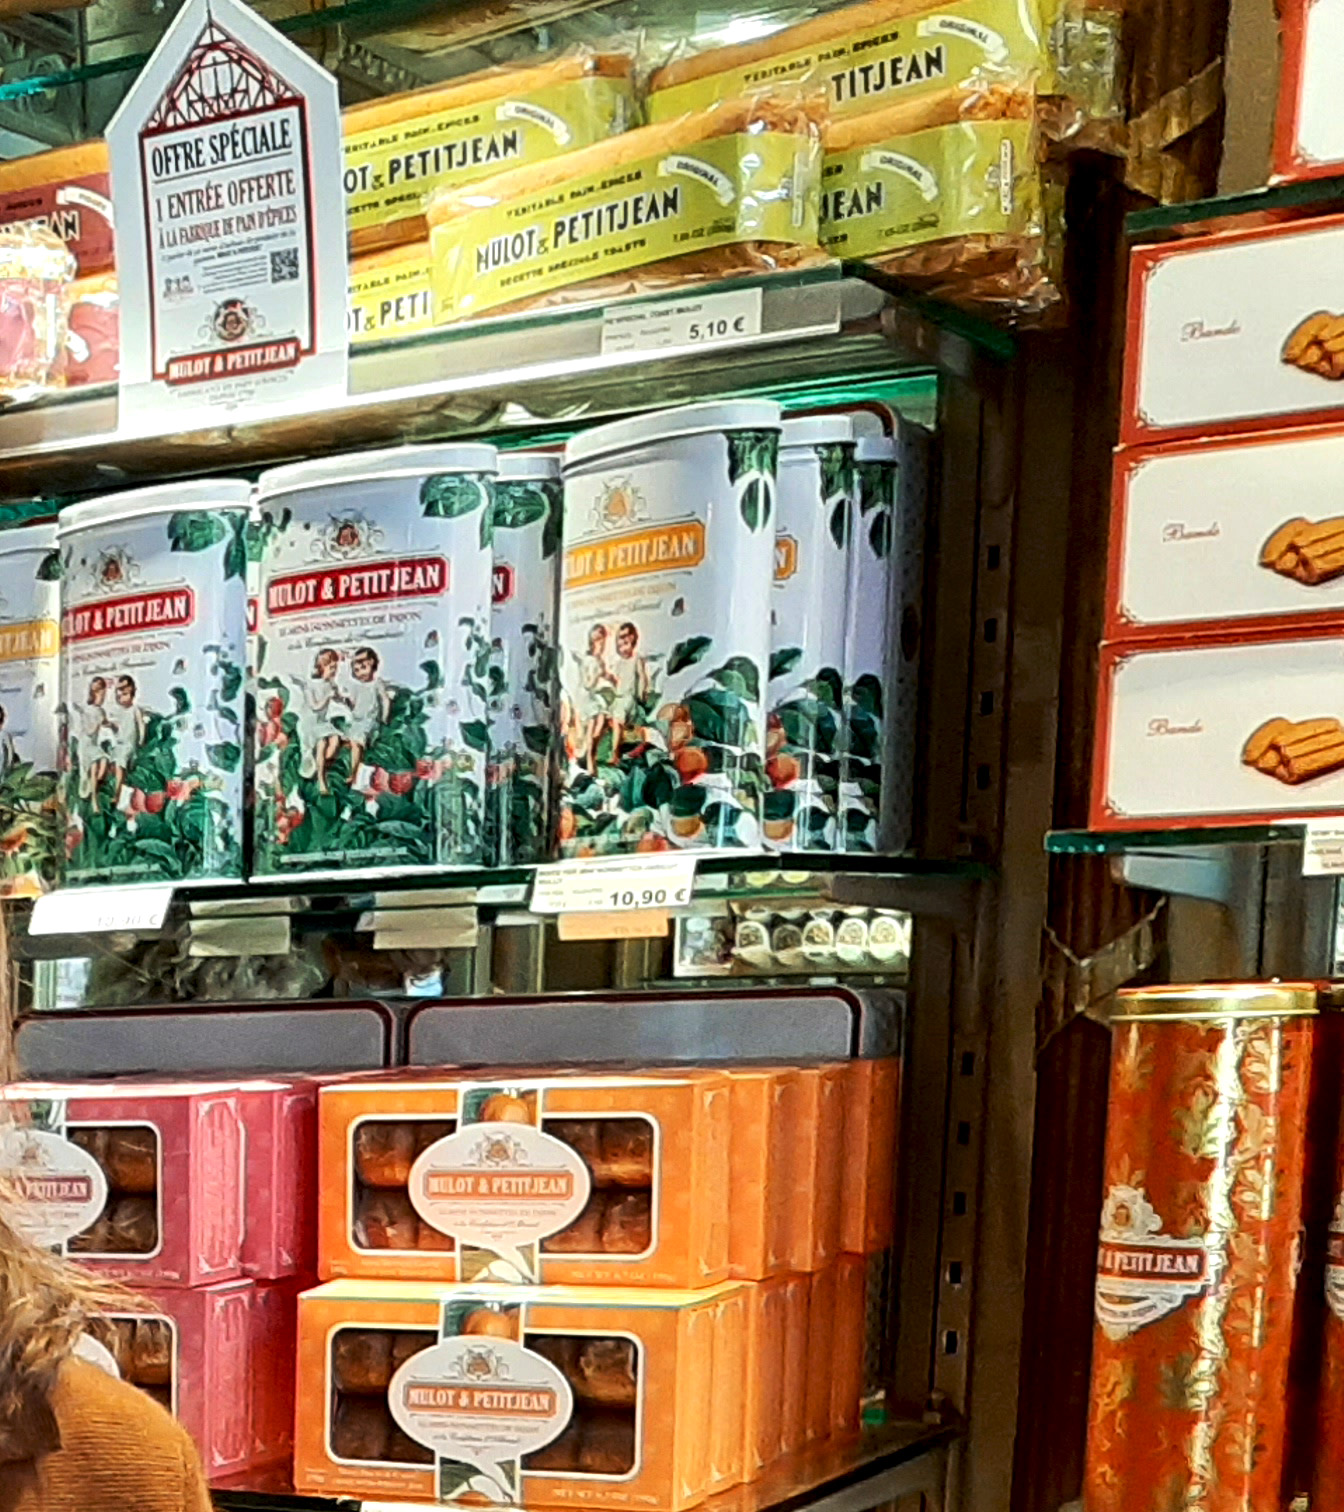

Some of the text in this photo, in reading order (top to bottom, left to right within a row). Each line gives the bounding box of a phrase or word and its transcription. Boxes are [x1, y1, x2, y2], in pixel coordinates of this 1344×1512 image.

[831, 45, 944, 101] TITJEAN
[152, 119, 292, 176] OFFRE SPÉCIALE
[389, 130, 517, 184] PETITJEAN
[156, 169, 295, 222] 1 ENTRÉE OFFERTE
[167, 226, 177, 247] LA
[180, 220, 220, 244] FABRIQUE
[223, 218, 232, 235] DE
[236, 213, 257, 233] PAIN
[477, 229, 535, 273] MULOT
[554, 187, 679, 248] PETITJEAN
[689, 316, 744, 340] 5,10 €
[170, 344, 295, 380] MULOT & PETITJEAN
[596, 533, 695, 573] & PETITJEAN
[269, 564, 439, 607] MULOT & PETITJEAN
[94, 596, 187, 628] & PETITJEAN
[610, 889, 666, 909] 10,90
[675, 889, 686, 901] €
[429, 1176, 567, 1194] MULOT & PETITJEAN
[408, 1388, 550, 1411] MULOT & PETITJEAN
